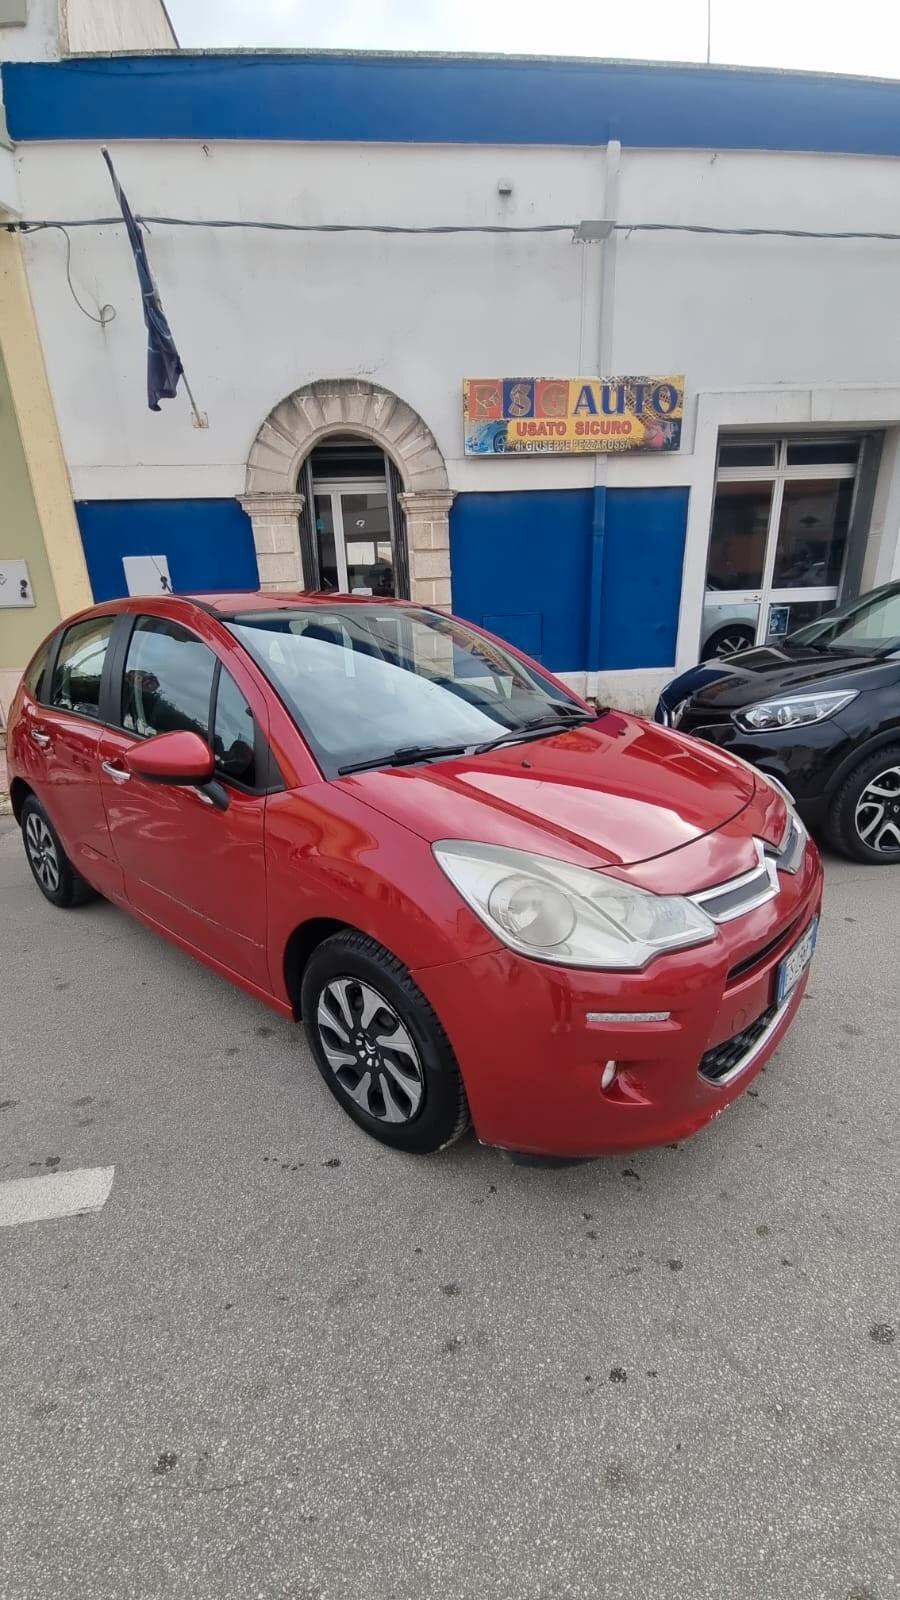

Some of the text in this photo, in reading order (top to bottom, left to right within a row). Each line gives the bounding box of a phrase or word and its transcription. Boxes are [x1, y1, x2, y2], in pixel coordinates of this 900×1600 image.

[516, 420, 632, 436] USATO SICURO
[526, 440, 571, 451] GIUSEPPE
[573, 438, 632, 449] PEZZAROSSA
